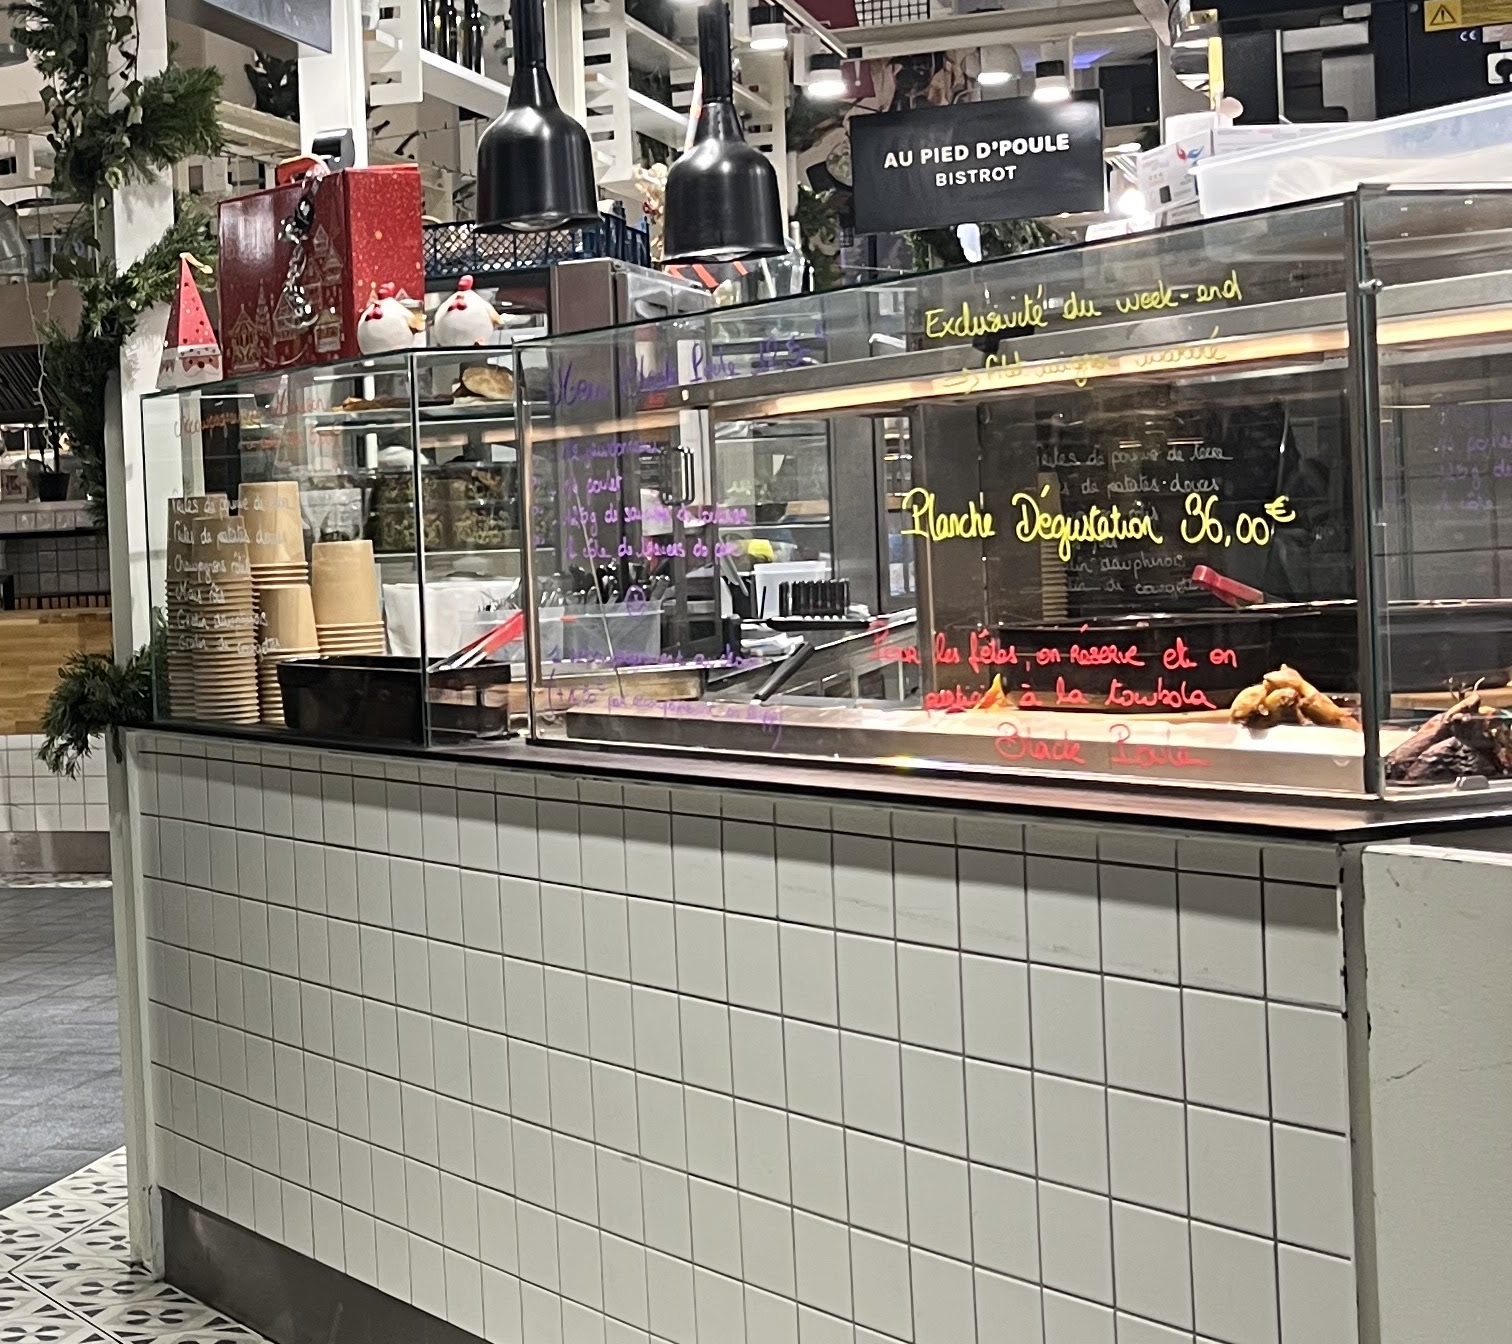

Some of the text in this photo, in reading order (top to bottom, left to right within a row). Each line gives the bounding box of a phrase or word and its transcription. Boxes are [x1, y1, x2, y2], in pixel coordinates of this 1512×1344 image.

[884, 133, 1070, 169] AU PIED D'POULE
[935, 165, 1017, 187] BISTROT
[925, 284, 1047, 338] Exclusivité
[1062, 291, 1101, 319] du
[901, 487, 995, 541] Planche
[1012, 485, 1163, 561] Dégustation
[934, 631, 960, 664] les
[1036, 647, 1061, 666] on
[1163, 636, 1197, 670] et
[1209, 647, 1237, 667] on
[1056, 675, 1087, 706] la
